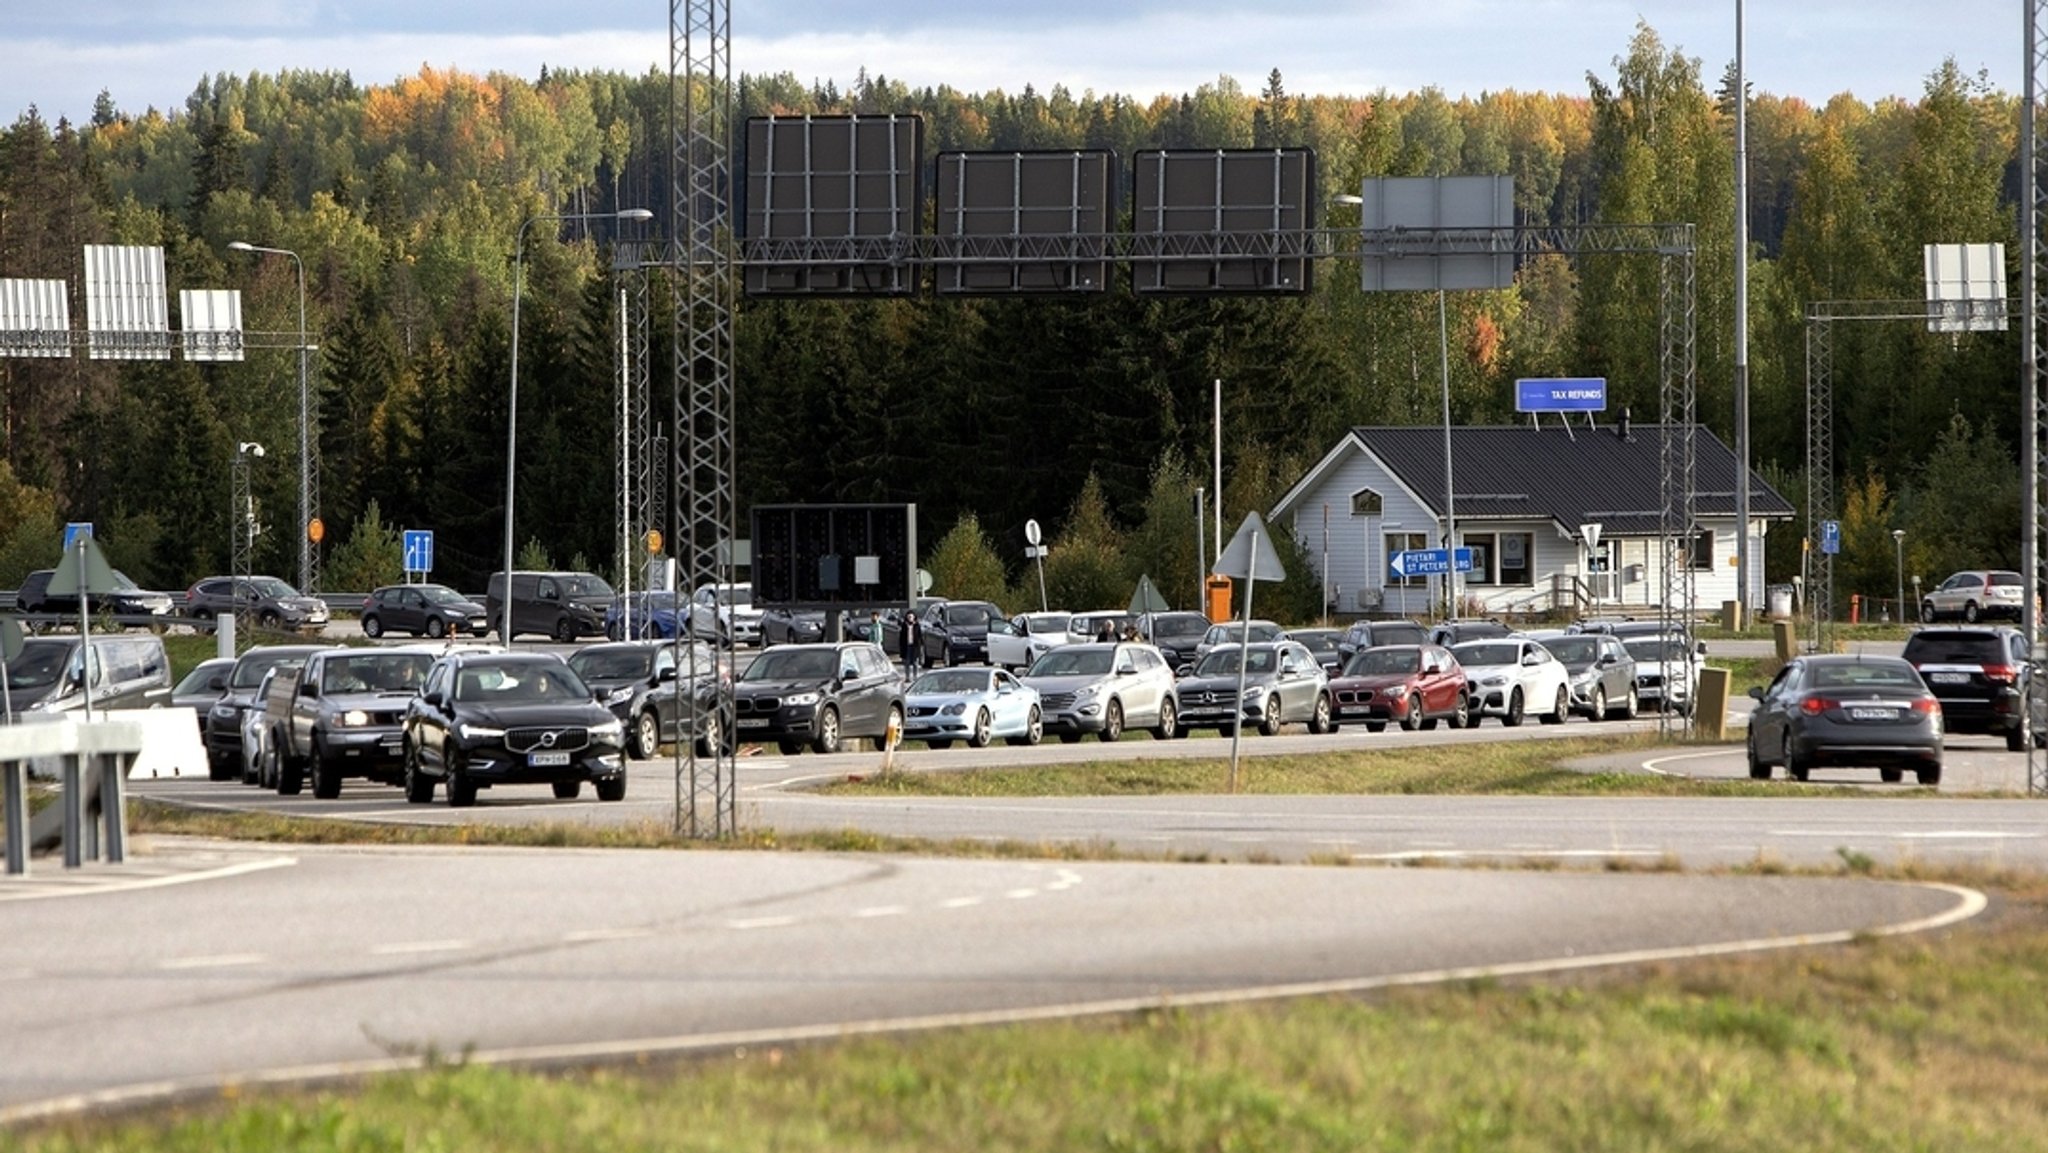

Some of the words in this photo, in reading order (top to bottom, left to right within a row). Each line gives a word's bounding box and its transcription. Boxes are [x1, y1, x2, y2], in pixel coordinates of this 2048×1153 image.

[1551, 390, 1567, 399] TAX
[1568, 389, 1602, 399] REFUNDS
[1827, 522, 1837, 539] P
[1406, 552, 1436, 563] PIETARI
[1406, 563, 1417, 573] ST
